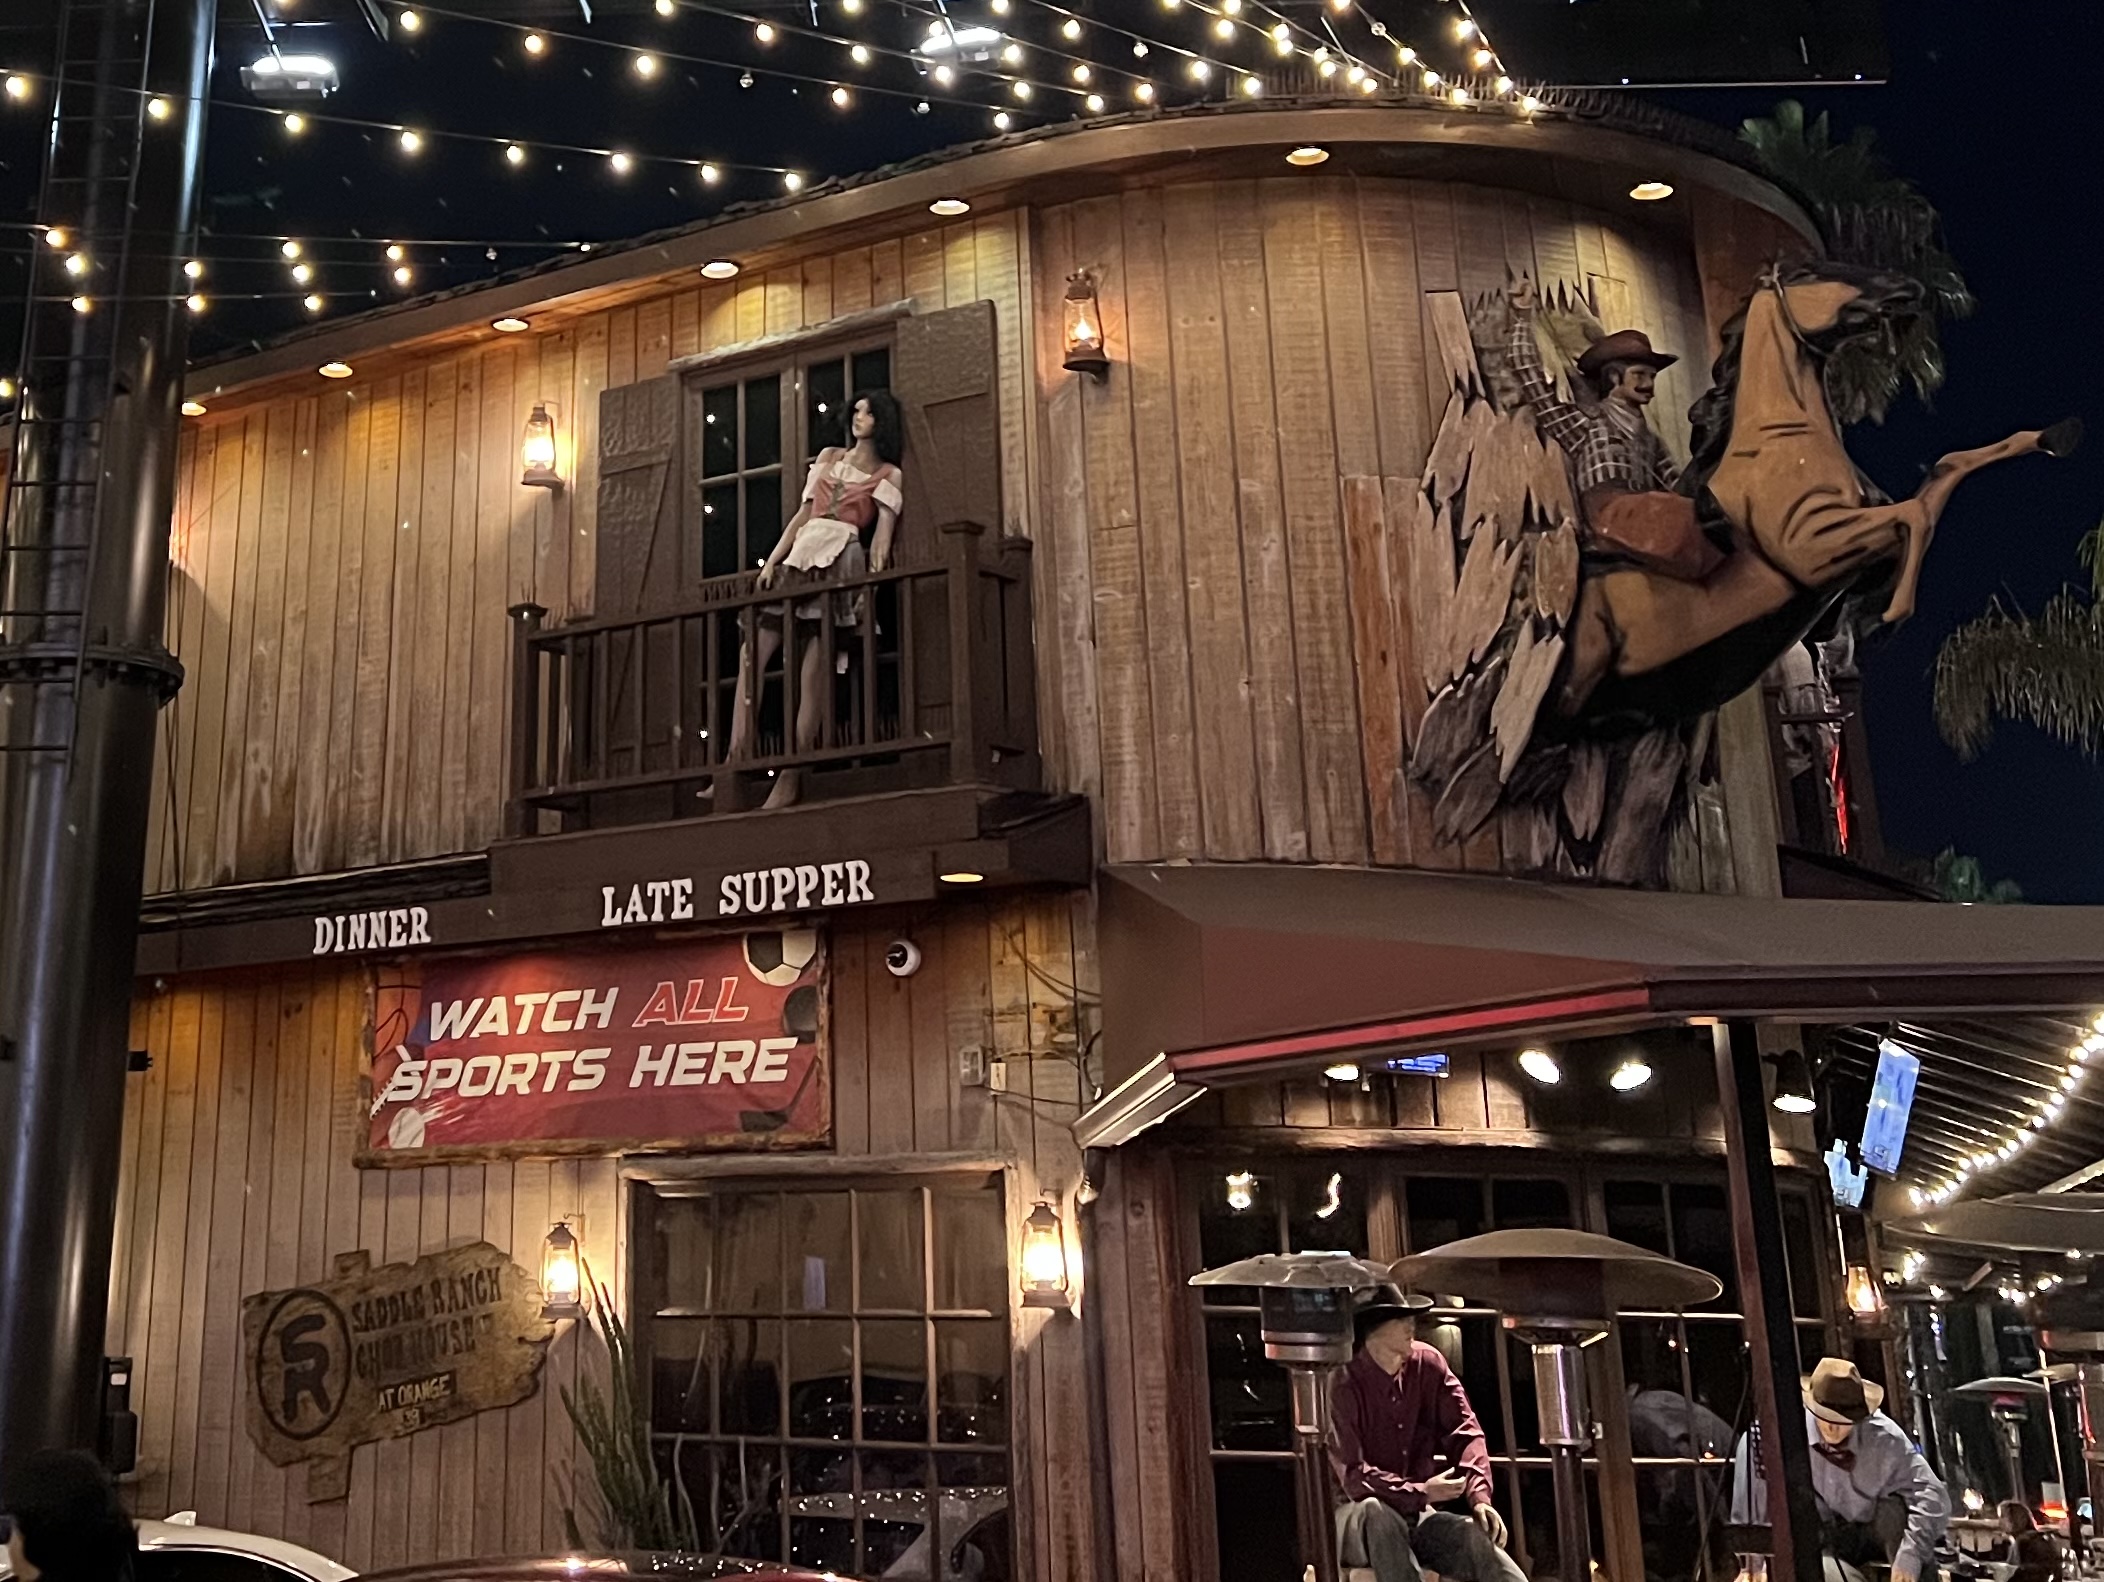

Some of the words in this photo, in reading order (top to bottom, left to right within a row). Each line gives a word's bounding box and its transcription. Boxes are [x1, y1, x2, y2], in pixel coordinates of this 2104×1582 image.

[601, 878, 694, 927] LATE
[719, 860, 875, 915] SUPPER
[312, 906, 431, 955] DINNER
[430, 987, 619, 1041] WATCH
[632, 976, 750, 1028] ALL
[387, 1047, 612, 1103] SPORTS
[629, 1037, 799, 1089] HERE
[352, 1285, 426, 1332] SADDLE
[430, 1266, 502, 1315] RANCH
[378, 1388, 395, 1412] AT
[398, 1374, 450, 1405] ORANGE
